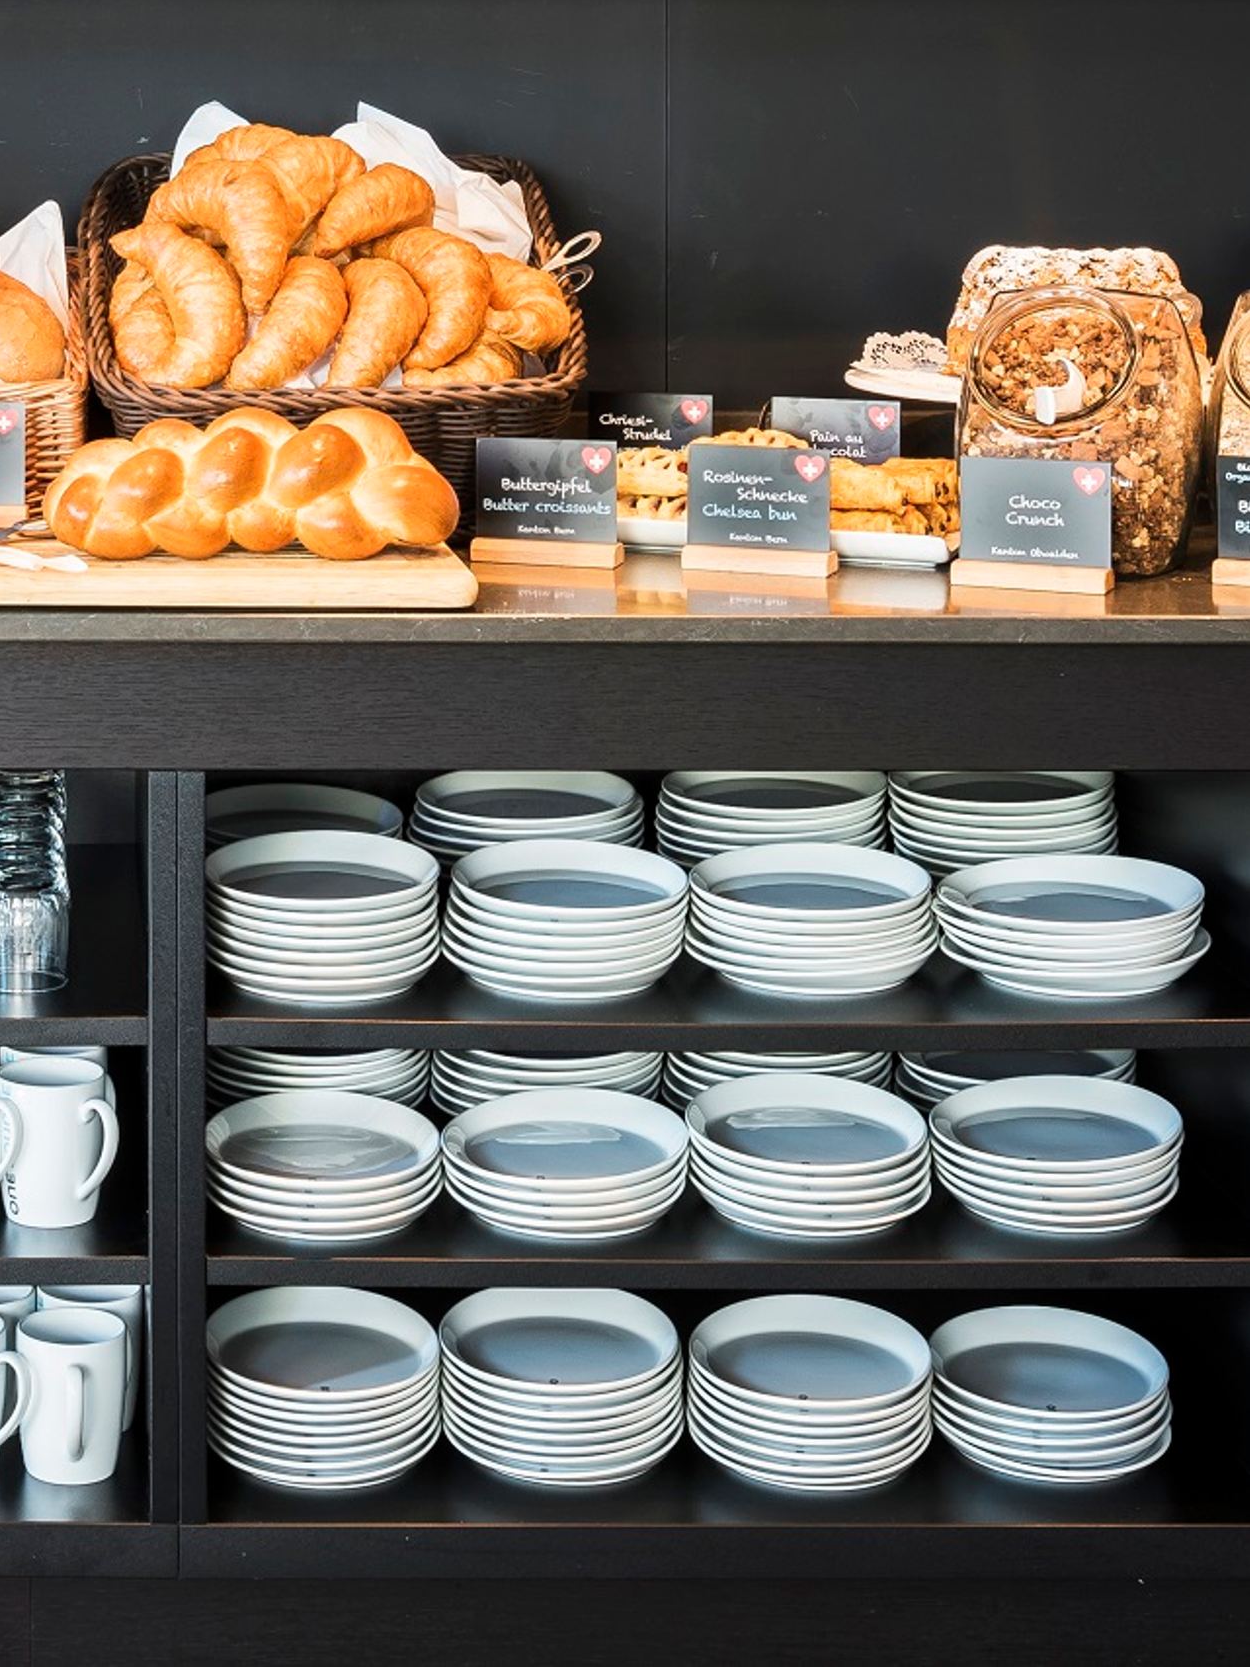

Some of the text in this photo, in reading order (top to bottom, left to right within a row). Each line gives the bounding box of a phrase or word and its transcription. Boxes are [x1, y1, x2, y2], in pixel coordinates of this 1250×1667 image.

[809, 429, 840, 443] Pain
[703, 470, 773, 485] Rosinen-
[501, 477, 592, 496] Buttergipfel
[737, 487, 808, 503] Schnecke
[1008, 495, 1062, 510] Choco
[483, 498, 612, 516] Butter croissants
[703, 504, 798, 521] Chelsea bun
[1005, 511, 1065, 528] Crunch
